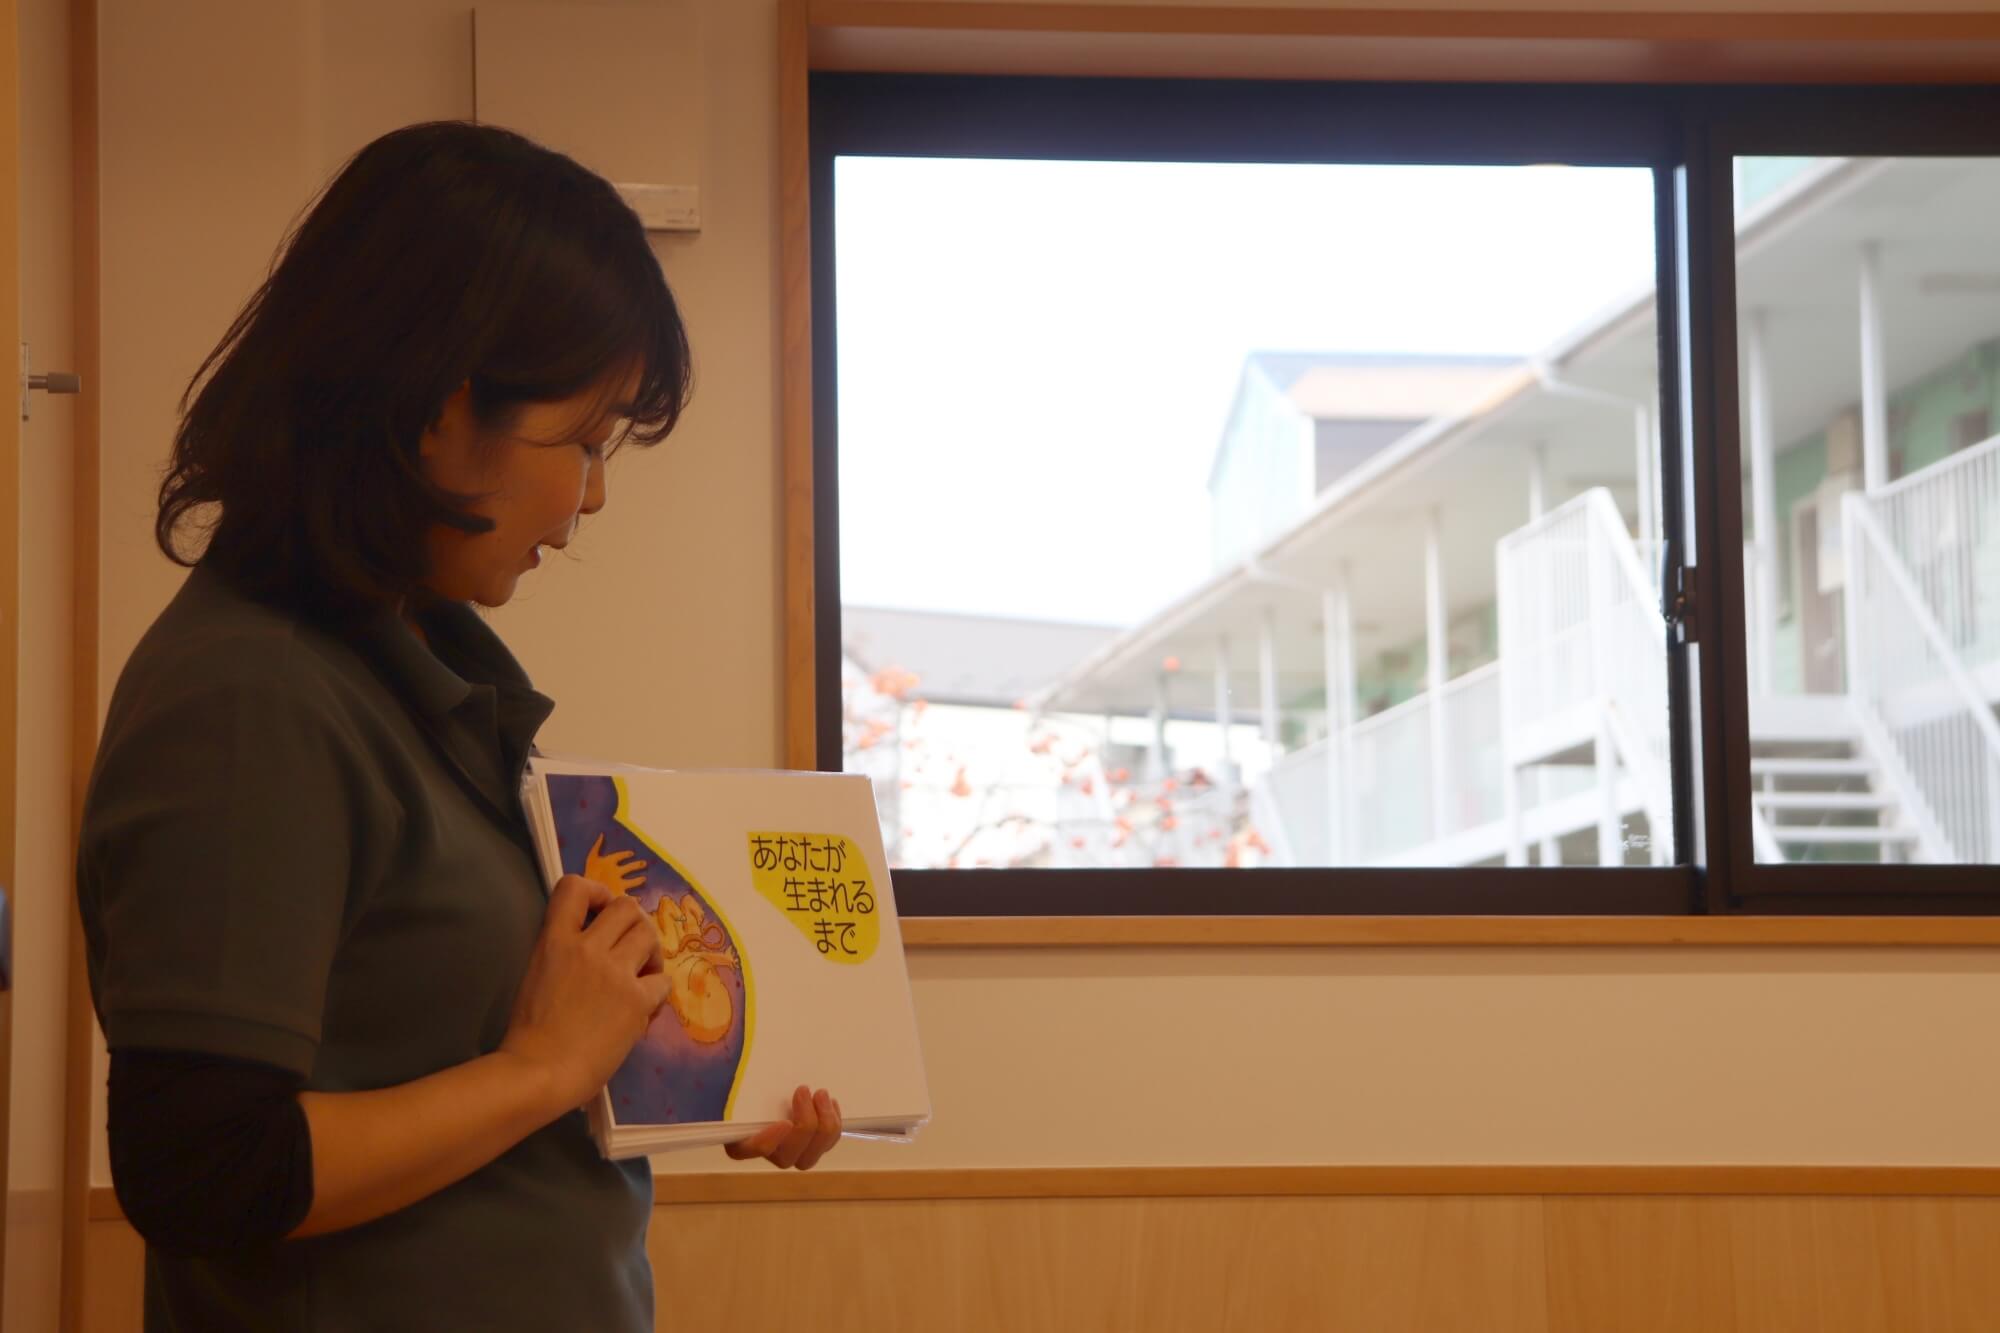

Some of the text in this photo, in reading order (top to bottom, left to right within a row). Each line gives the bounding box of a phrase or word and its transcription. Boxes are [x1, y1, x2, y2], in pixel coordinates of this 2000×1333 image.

[751, 836, 846, 873] あなたが
[783, 877, 874, 914] 生まれる
[814, 918, 858, 954] まで
